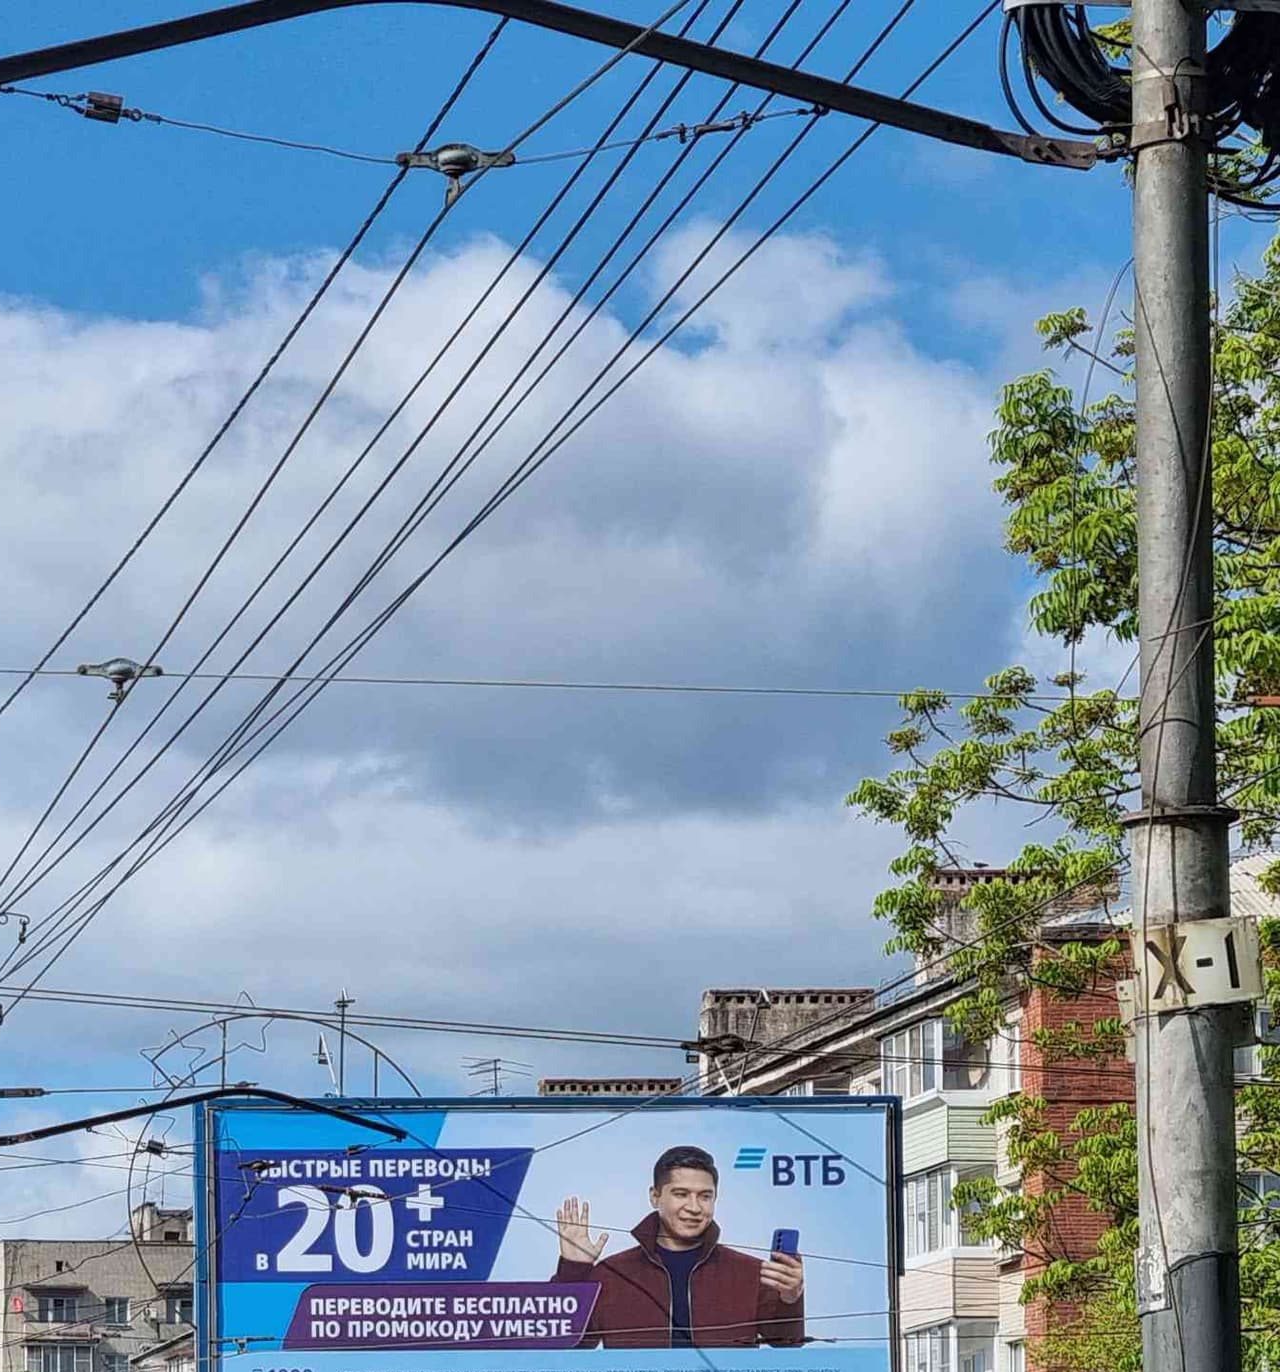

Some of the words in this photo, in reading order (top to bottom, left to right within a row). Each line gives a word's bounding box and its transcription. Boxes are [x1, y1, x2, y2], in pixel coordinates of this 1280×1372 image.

[369, 1158, 490, 1180] ПЕРЕВОДЫ
[772, 1155, 846, 1186] ВТБ
[406, 1230, 473, 1248] СТРАН
[407, 1252, 468, 1270] МИРА
[310, 1297, 446, 1318] ПЕРЕВОДИТЕ
[453, 1296, 578, 1315] БЕСПЛАТНО
[311, 1320, 340, 1338] ПО
[348, 1320, 483, 1340] ПРОМОКОДУ
[489, 1319, 573, 1337] VMESTE
